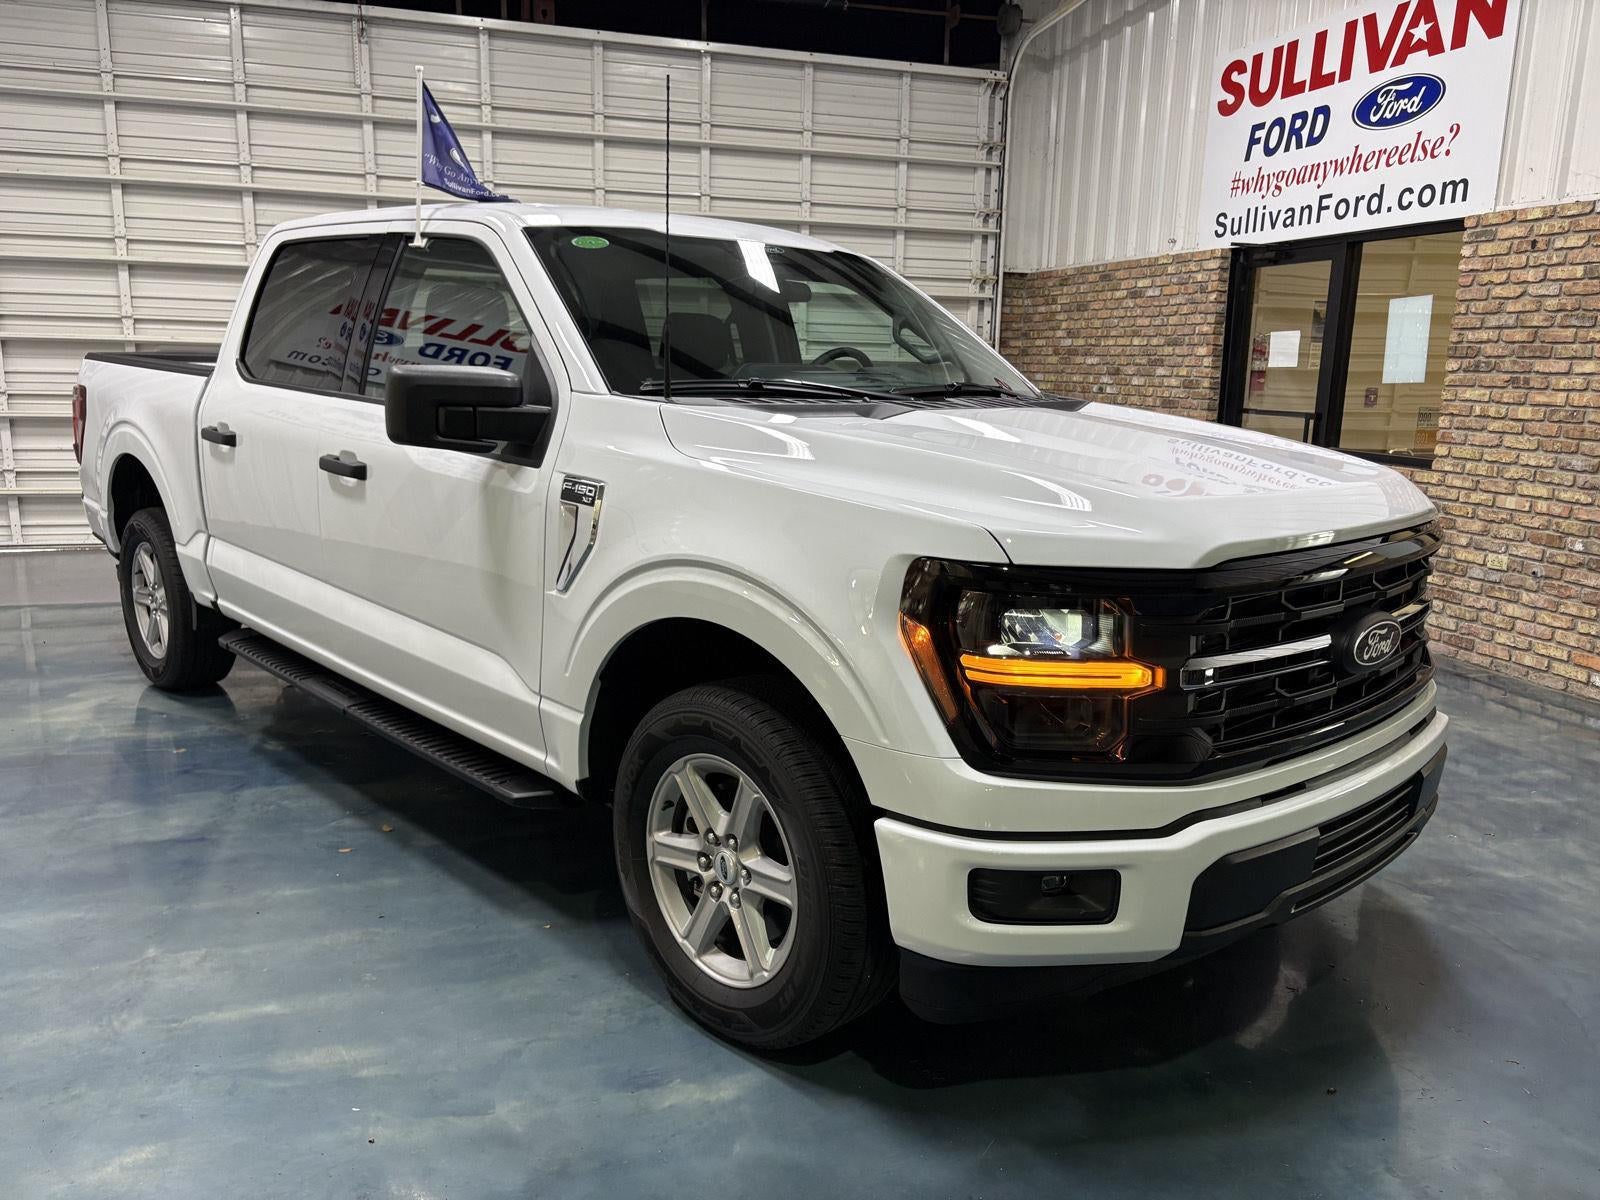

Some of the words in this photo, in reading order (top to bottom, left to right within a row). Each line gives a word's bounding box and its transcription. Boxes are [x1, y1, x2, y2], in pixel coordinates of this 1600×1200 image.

[1217, 0, 1507, 117] SULLIVAN
[1370, 82, 1427, 122] Ford
[1230, 123, 1460, 199] #whygoanywhereelse?
[1244, 104, 1331, 161] FORD
[1214, 178, 1469, 238] SullivanFord.com
[563, 482, 595, 497] F-150
[1363, 627, 1395, 660] Ford
